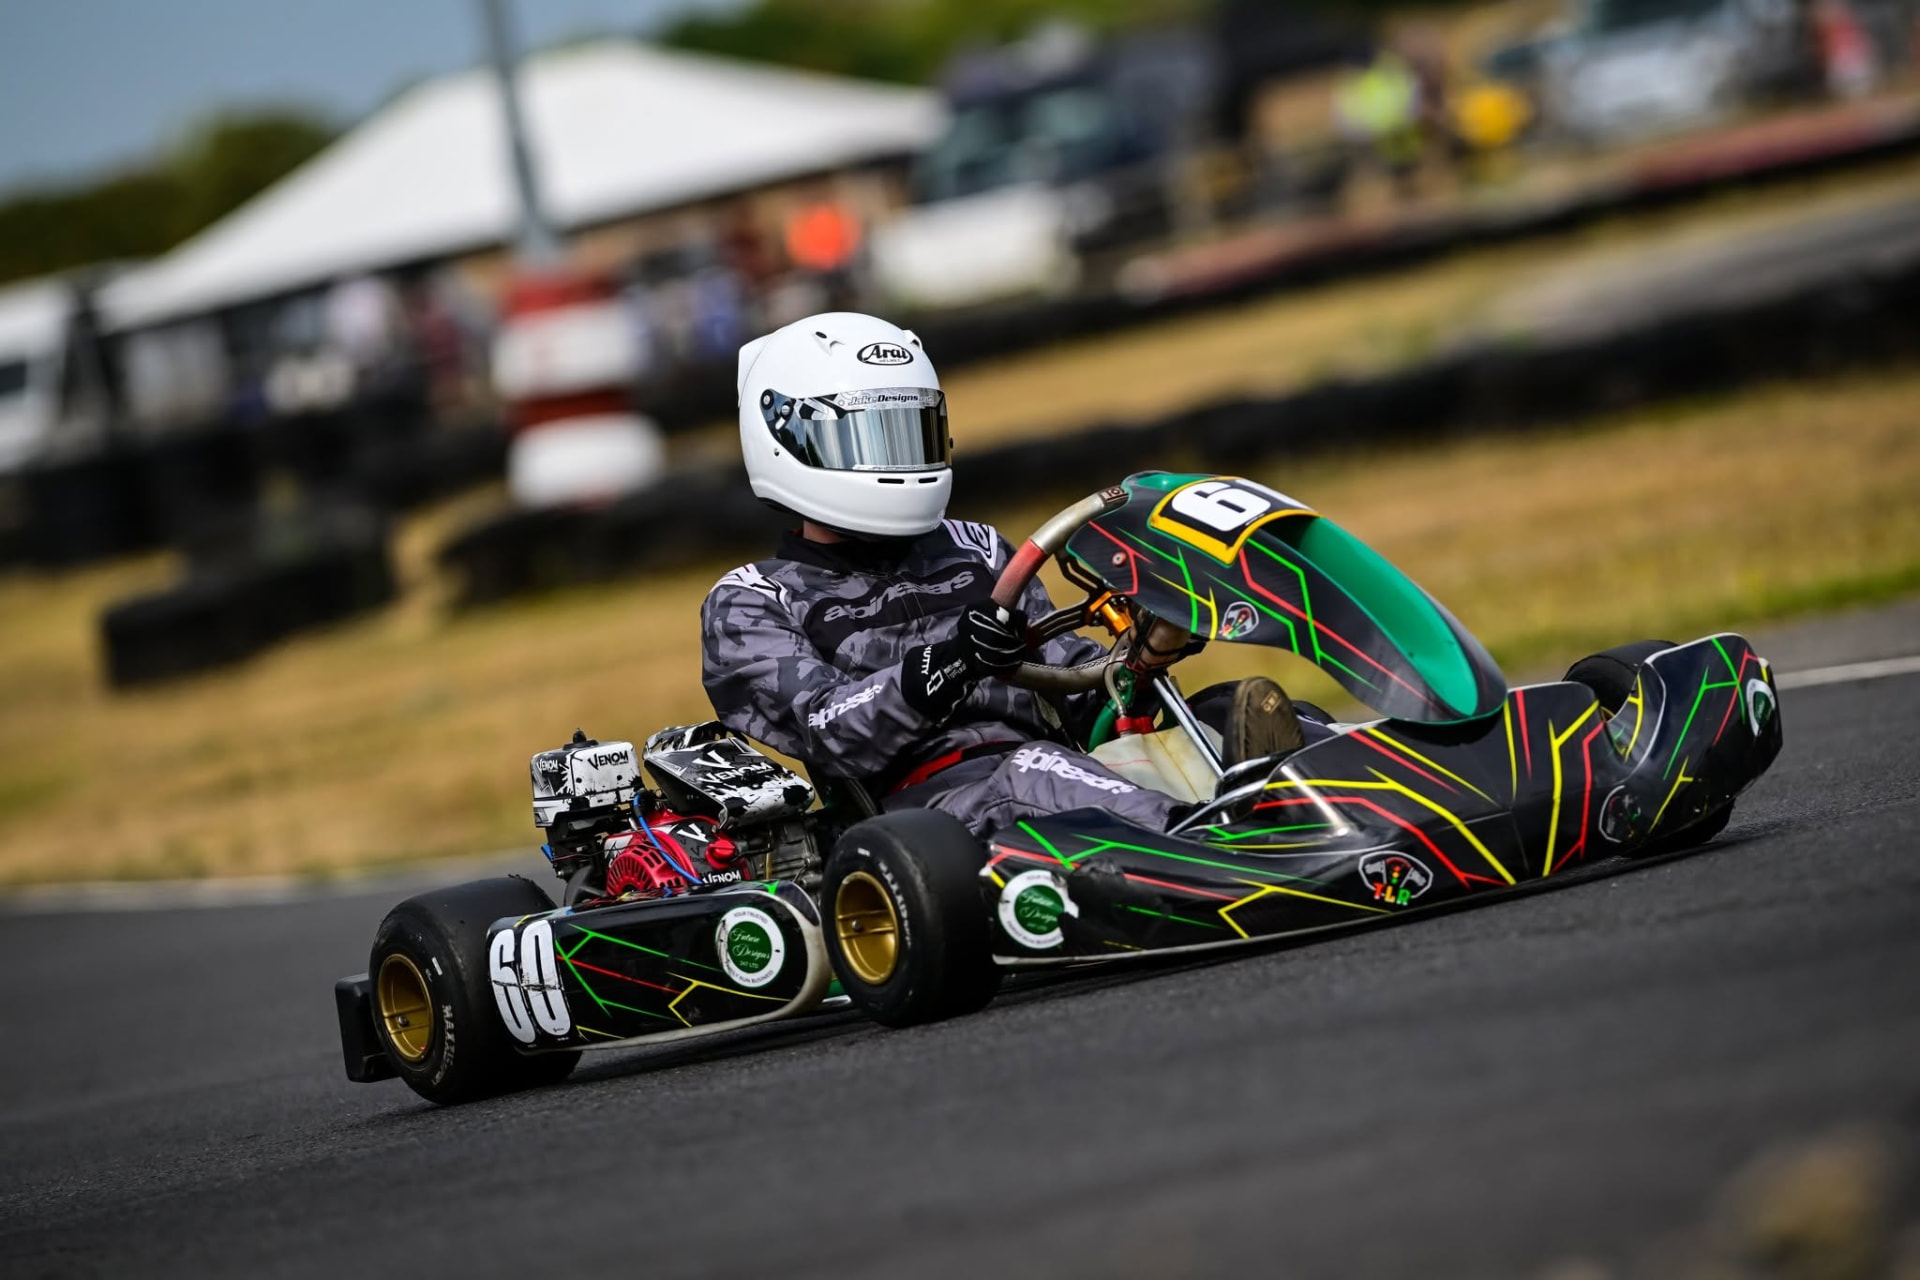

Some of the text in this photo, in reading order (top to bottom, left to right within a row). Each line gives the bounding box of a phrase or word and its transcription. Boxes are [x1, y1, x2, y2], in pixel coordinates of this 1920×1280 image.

[863, 344, 909, 361] Arai
[1172, 480, 1315, 532] 6
[536, 758, 559, 774] VENOM
[587, 749, 629, 771] VENOM
[696, 761, 776, 784] VENOM
[1019, 906, 1059, 924] Design
[729, 927, 761, 943] Future
[731, 943, 770, 961] Designs
[489, 919, 572, 1044] 60
